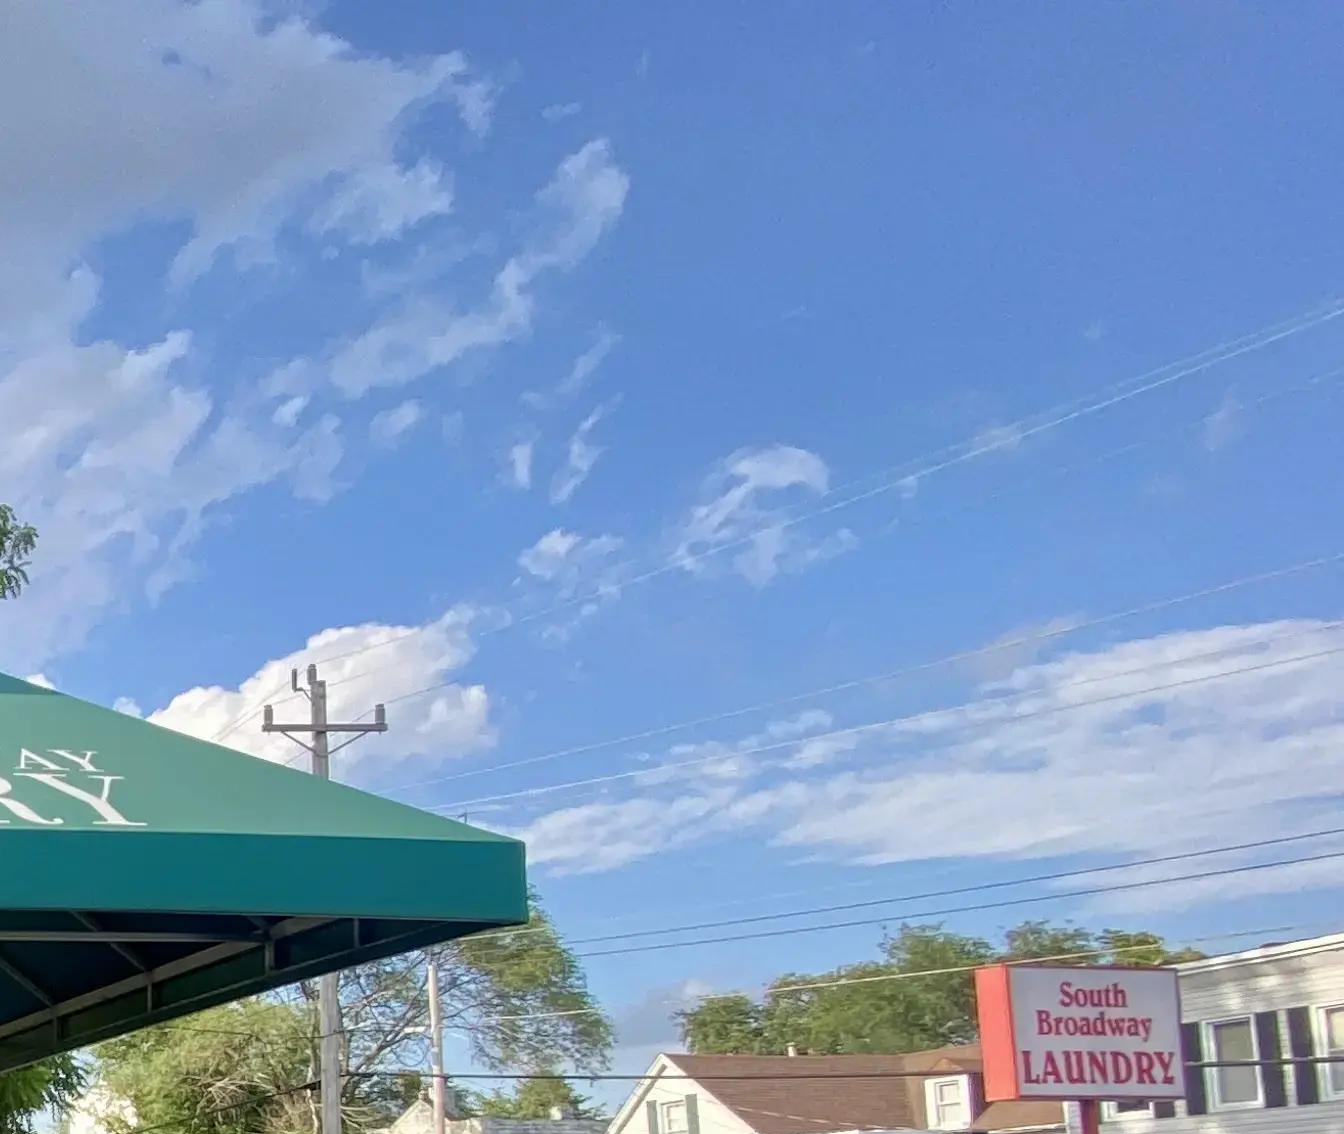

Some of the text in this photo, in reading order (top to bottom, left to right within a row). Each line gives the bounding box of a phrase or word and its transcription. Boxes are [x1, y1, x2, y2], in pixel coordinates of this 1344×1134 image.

[1058, 981, 1128, 1008] South
[1035, 1010, 1153, 1042] Broadway
[1020, 1050, 1176, 1085] LAUNDRY
